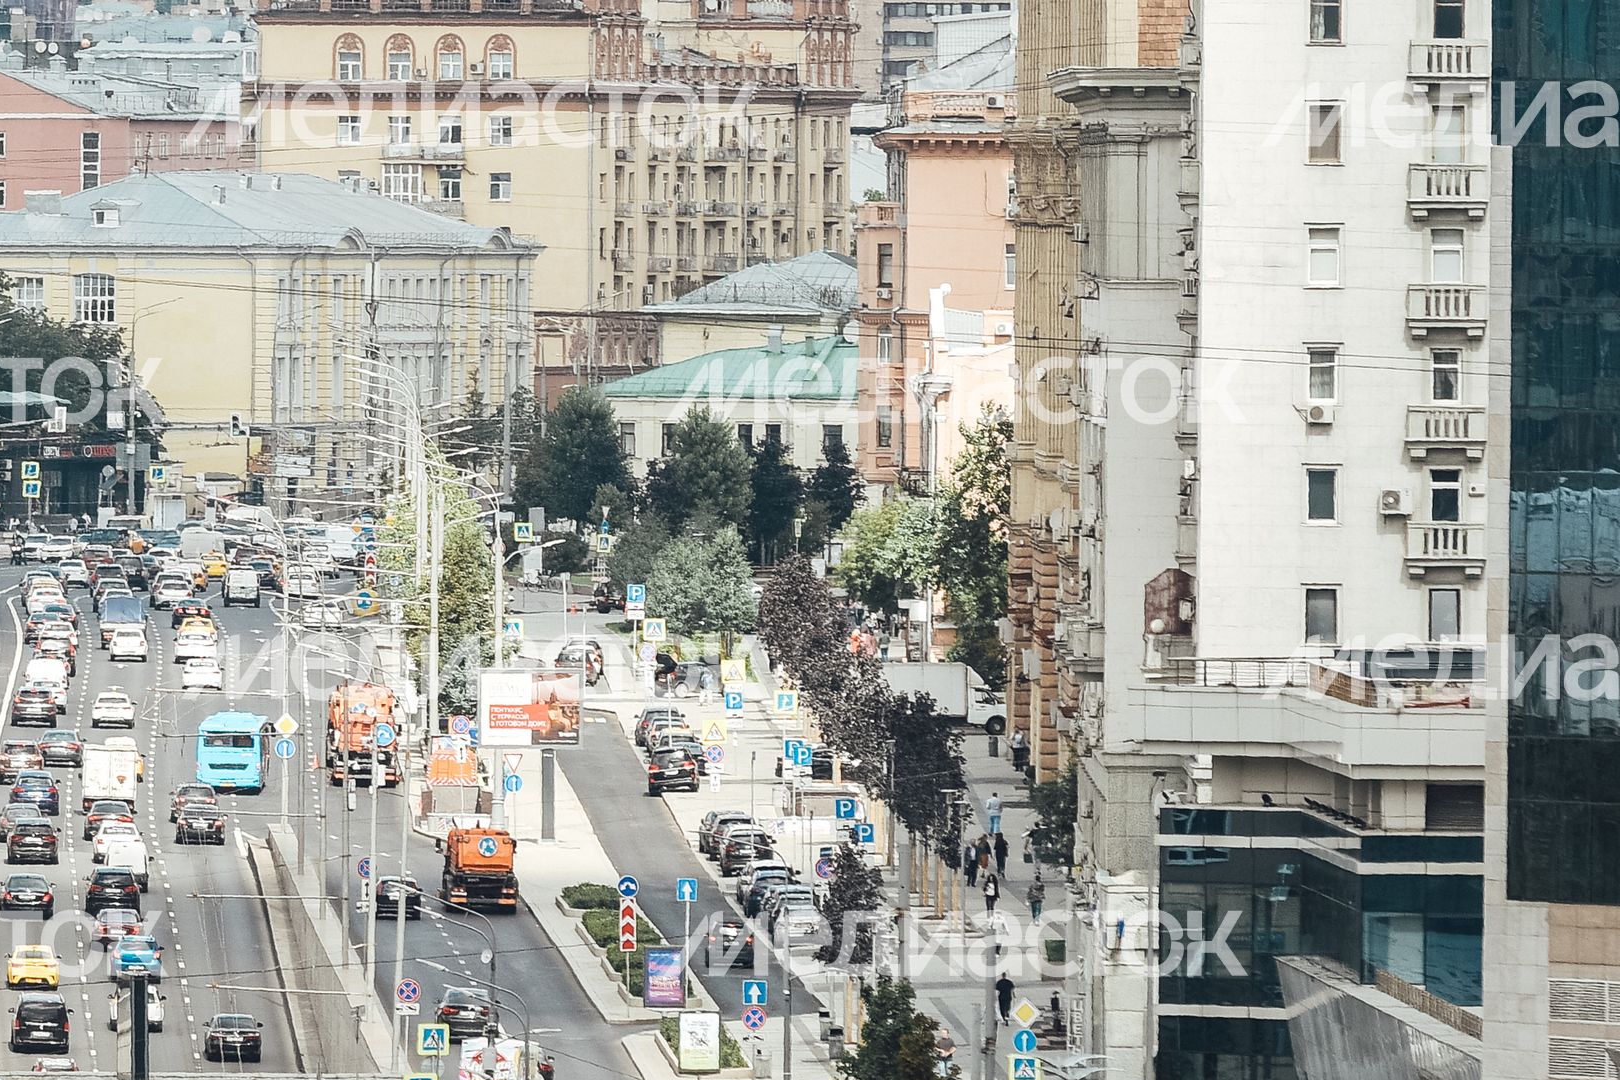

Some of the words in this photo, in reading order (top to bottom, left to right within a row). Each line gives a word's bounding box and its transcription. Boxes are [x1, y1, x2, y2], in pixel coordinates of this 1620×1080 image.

[798, 750, 809, 764] P
[841, 801, 852, 817] P
[860, 826, 871, 842] P
